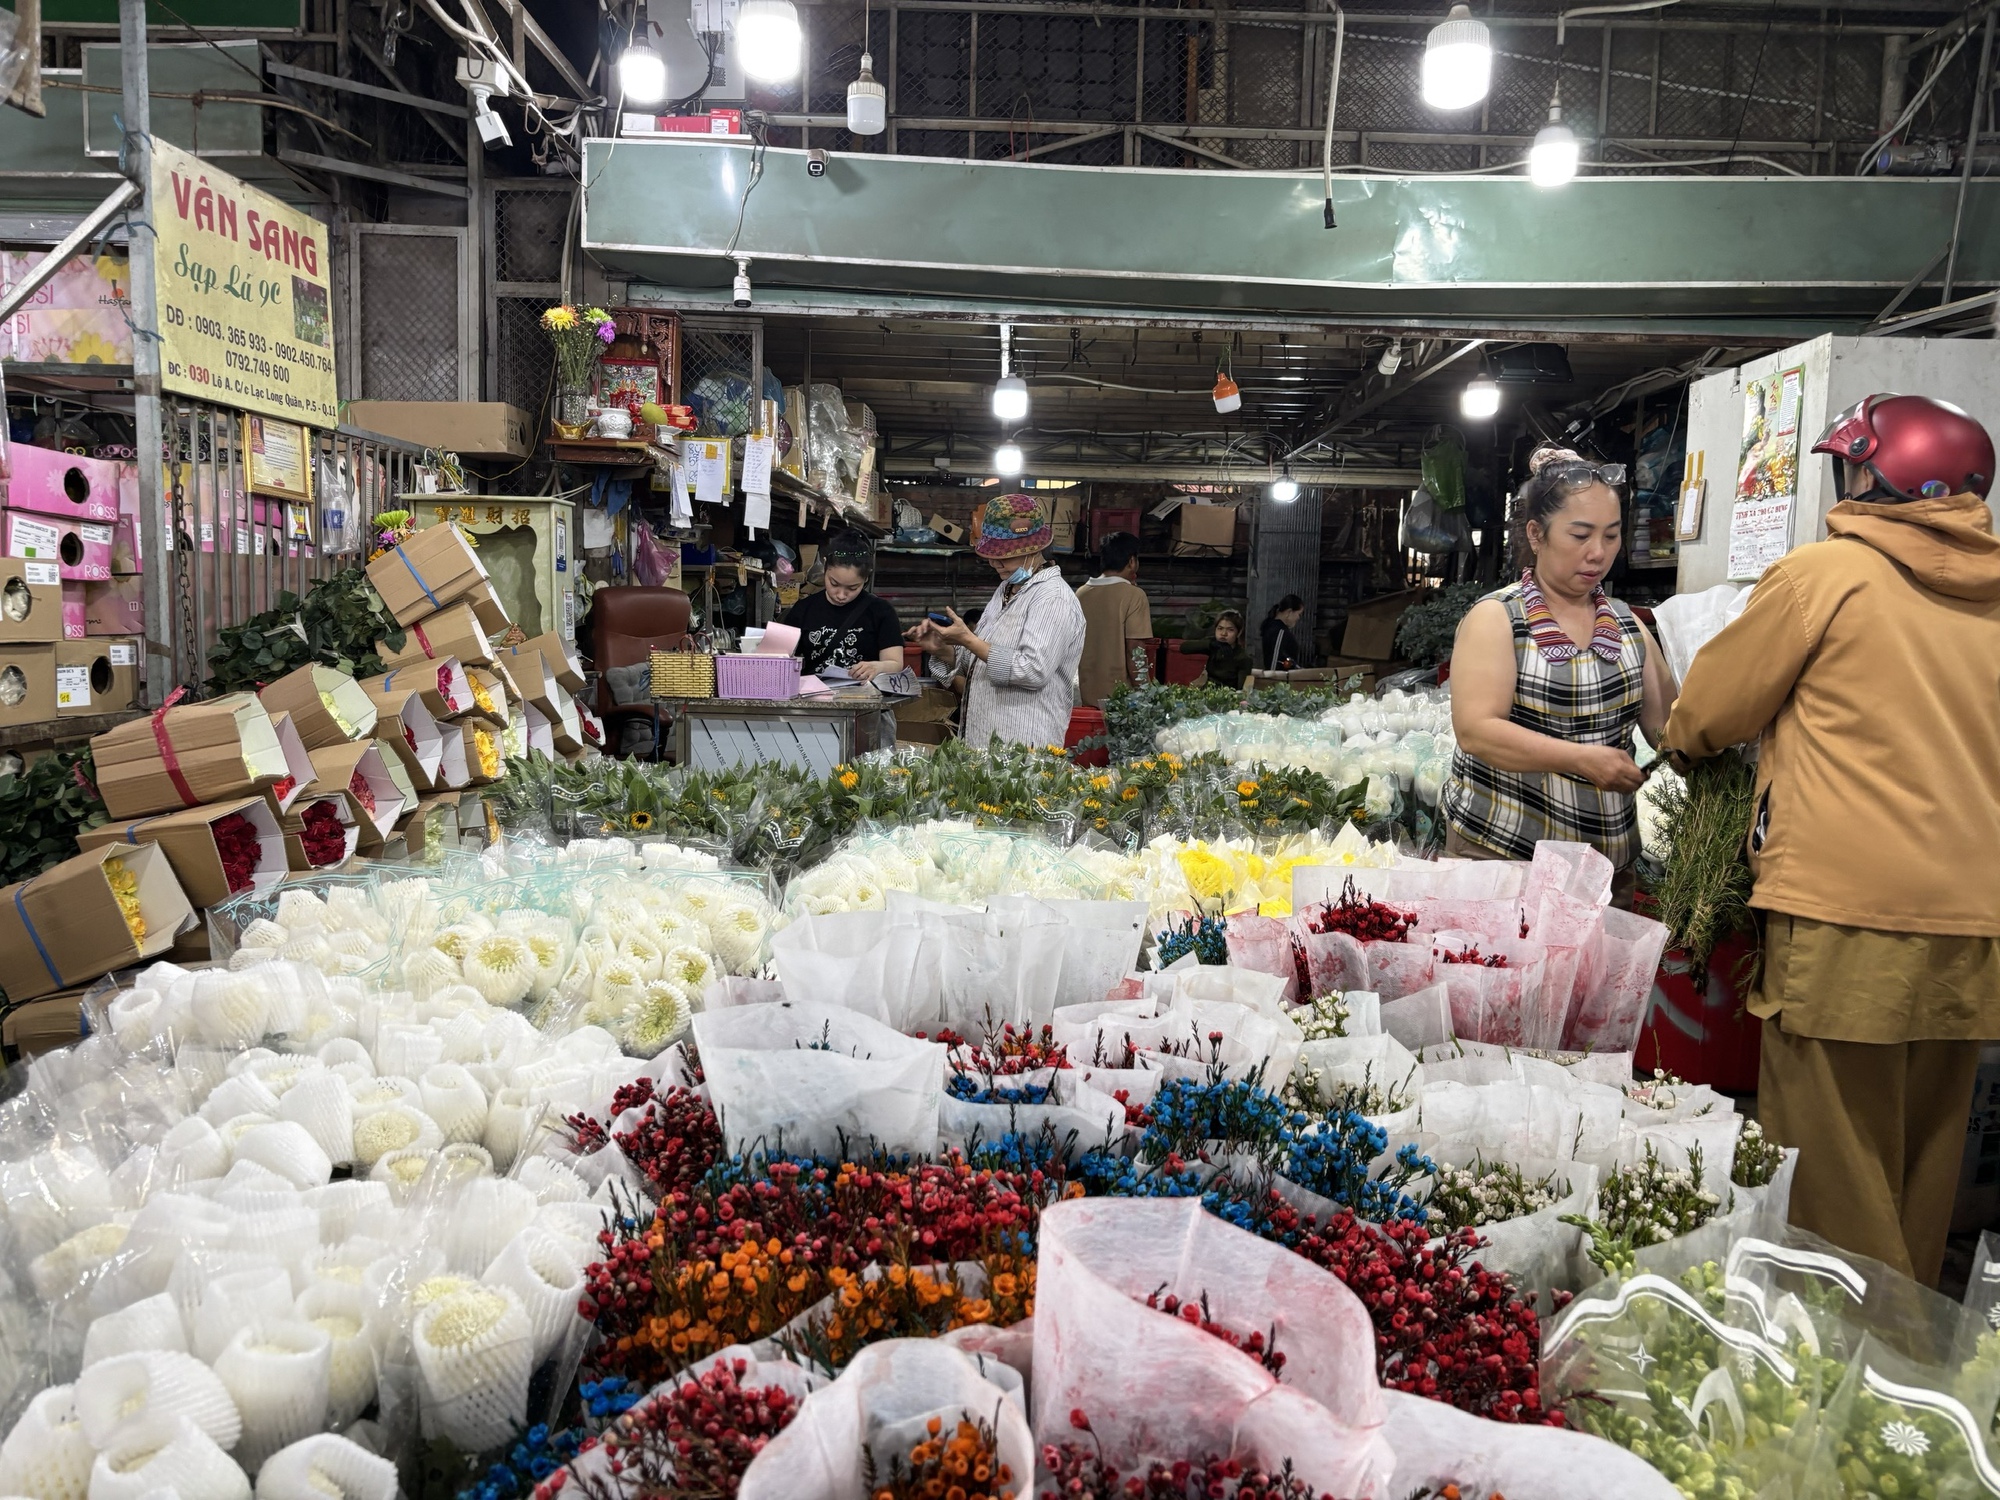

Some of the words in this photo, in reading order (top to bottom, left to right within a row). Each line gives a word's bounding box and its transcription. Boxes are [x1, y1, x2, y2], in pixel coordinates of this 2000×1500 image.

[171, 170, 238, 243] VÂN
[247, 209, 318, 277] SANG
[174, 243, 218, 295] Sạp
[223, 264, 253, 303] Lá
[166, 304, 184, 326] DĐ
[196, 315, 225, 341] 0903.
[227, 325, 246, 347] 365
[250, 333, 266, 354] 933
[275, 342, 333, 374] 0902.450.764
[226, 350, 270, 378] 0792.749
[273, 364, 290, 383] 600
[168, 361, 181, 377] ĐC
[189, 364, 210, 385] 030
[212, 373, 222, 388] Lô
[225, 377, 233, 391] A.
[251, 384, 264, 400] Lạc
[266, 388, 283, 405] Long
[306, 399, 317, 412] P.5
[322, 403, 336, 417] Q.11
[89, 503, 118, 520] ROSSI
[710, 740, 727, 766] STAINLESS
[796, 743, 813, 768] STAINLESS
